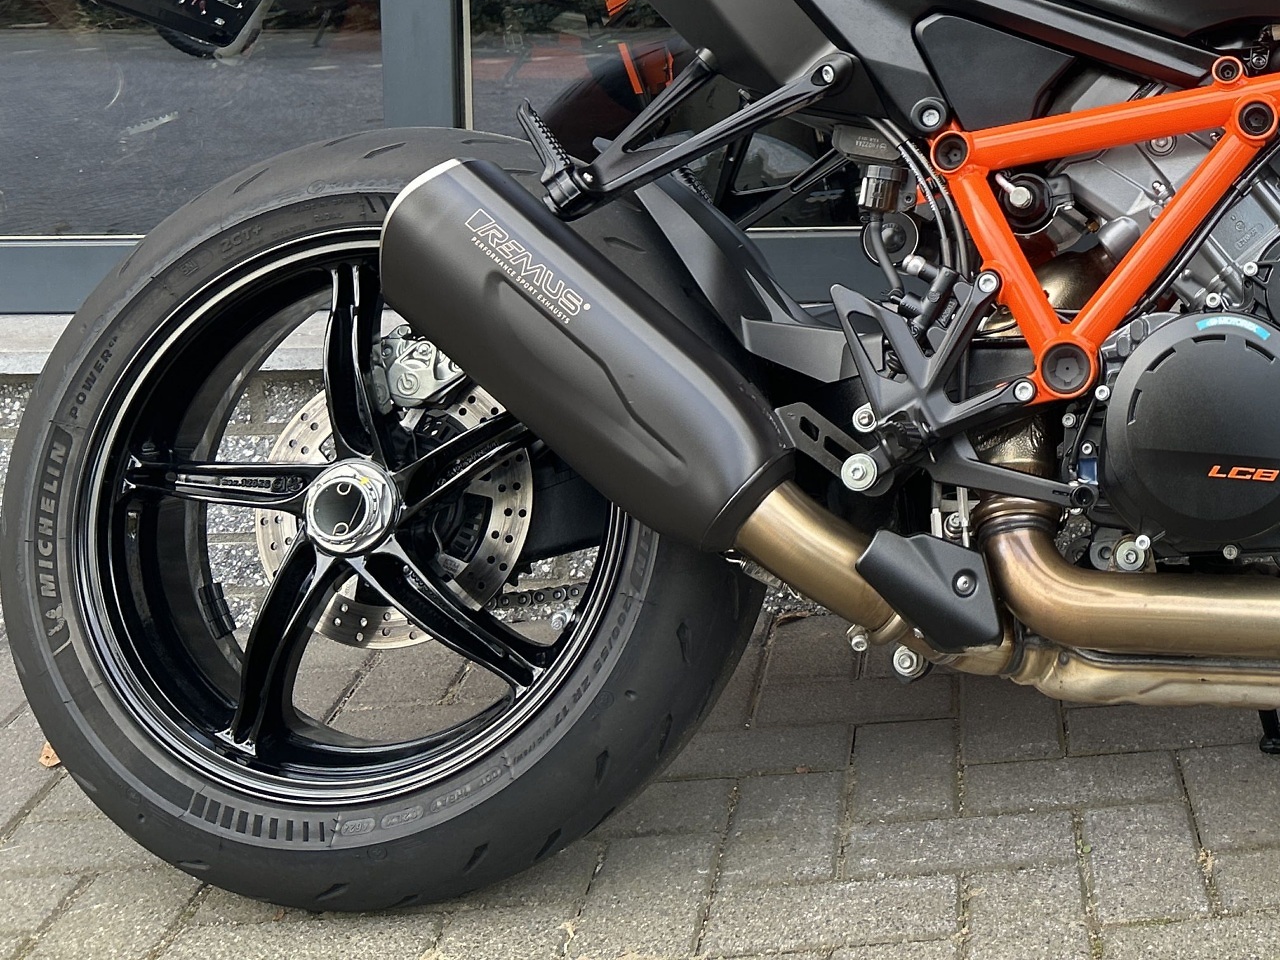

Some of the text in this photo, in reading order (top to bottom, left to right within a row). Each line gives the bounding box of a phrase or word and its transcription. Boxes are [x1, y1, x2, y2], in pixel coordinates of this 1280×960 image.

[470, 236, 571, 325] PERFORMANCE SPORT EXHAUSTS
[478, 224, 584, 316] REMUS
[37, 441, 68, 598] MICHELIN
[69, 348, 114, 420] POWER
[1208, 465, 1280, 482] LC8
